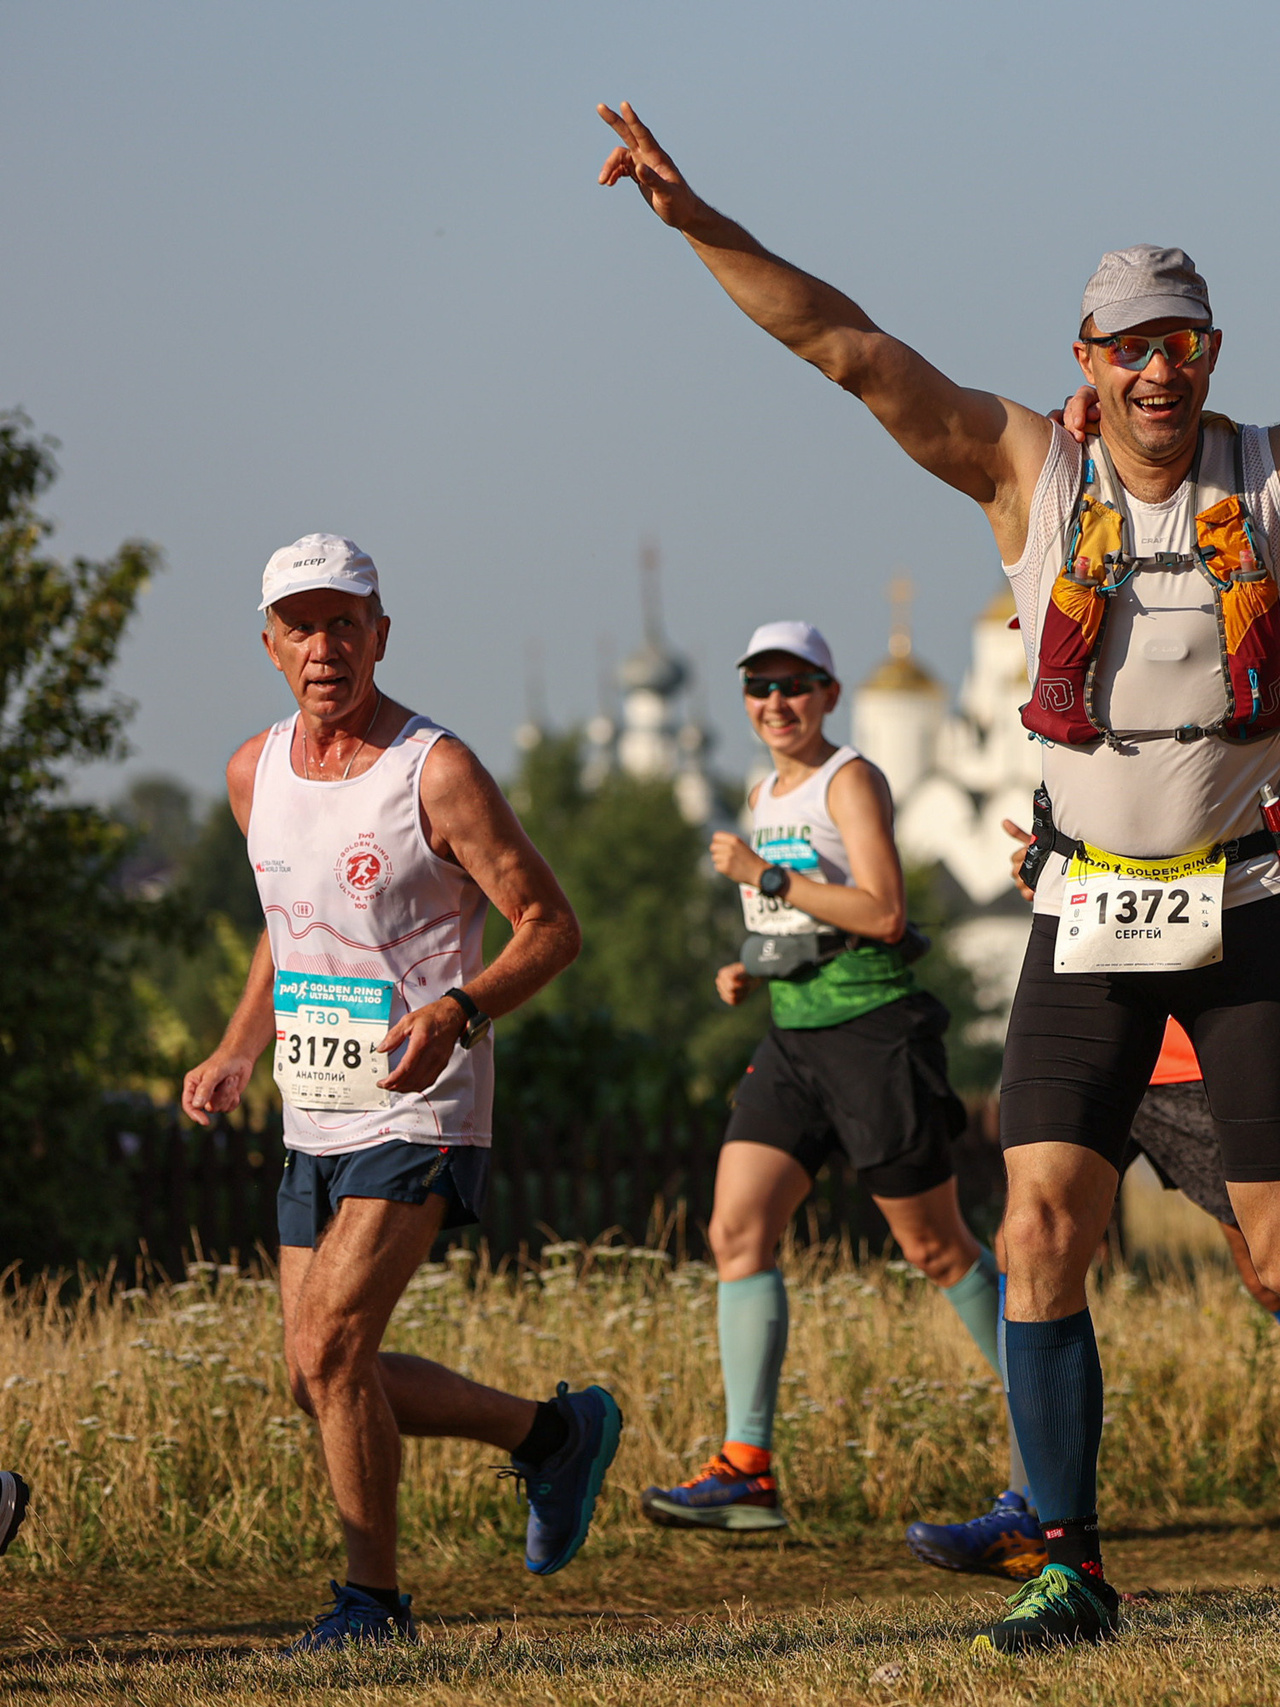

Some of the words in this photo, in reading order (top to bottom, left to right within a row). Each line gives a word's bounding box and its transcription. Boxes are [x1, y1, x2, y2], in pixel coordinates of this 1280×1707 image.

[303, 557, 326, 567] cep
[1126, 866, 1179, 876] GOLDEN
[1095, 889, 1190, 924] 1372
[1115, 927, 1162, 939] СЕРГЕЙ
[310, 983, 351, 994] GOLDEN
[353, 986, 383, 997] RING
[309, 992, 335, 1001] ULTRA
[336, 994, 363, 1003] TRAIL
[364, 996, 382, 1004] 100
[305, 1010, 339, 1026] T30
[288, 1034, 362, 1069] 3178
[296, 1070, 346, 1082] АНАТОЛИЙ
